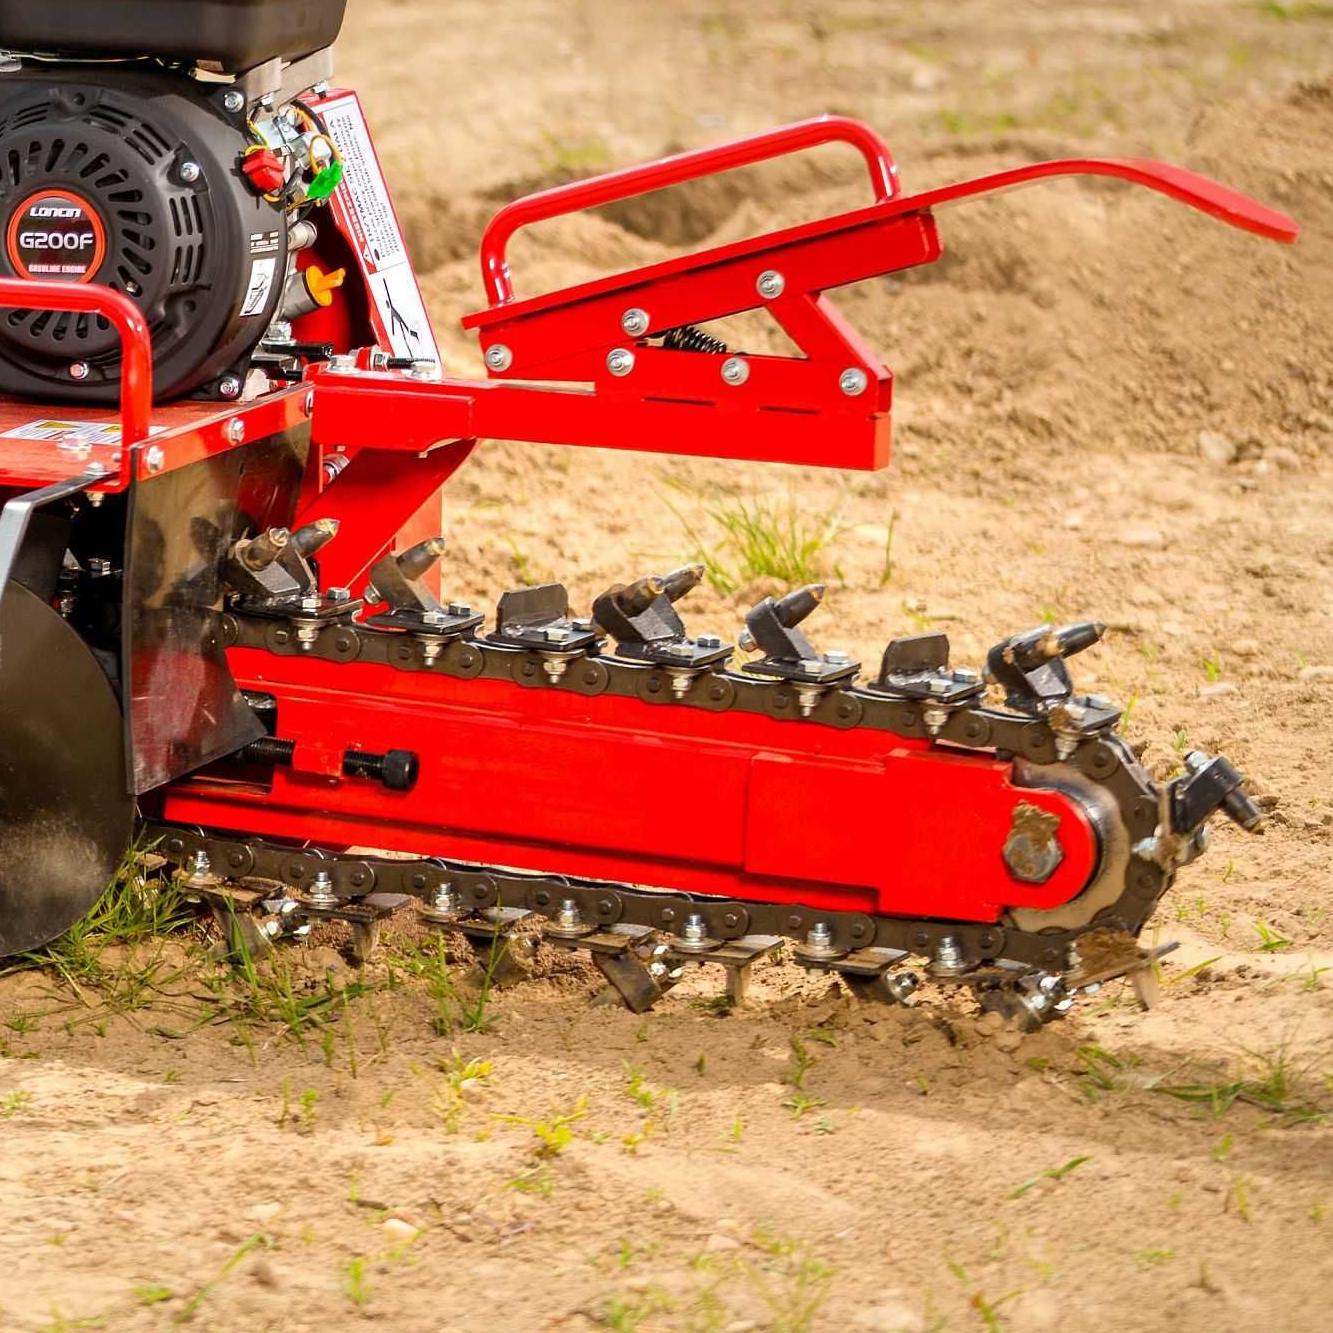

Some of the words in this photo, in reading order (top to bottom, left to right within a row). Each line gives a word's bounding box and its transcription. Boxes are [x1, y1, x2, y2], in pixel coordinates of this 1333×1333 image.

[30, 207, 81, 218] LONCIN
[20, 232, 93, 249] G200F
[29, 265, 61, 273] GASOLINE
[62, 265, 86, 273] ENGINE
